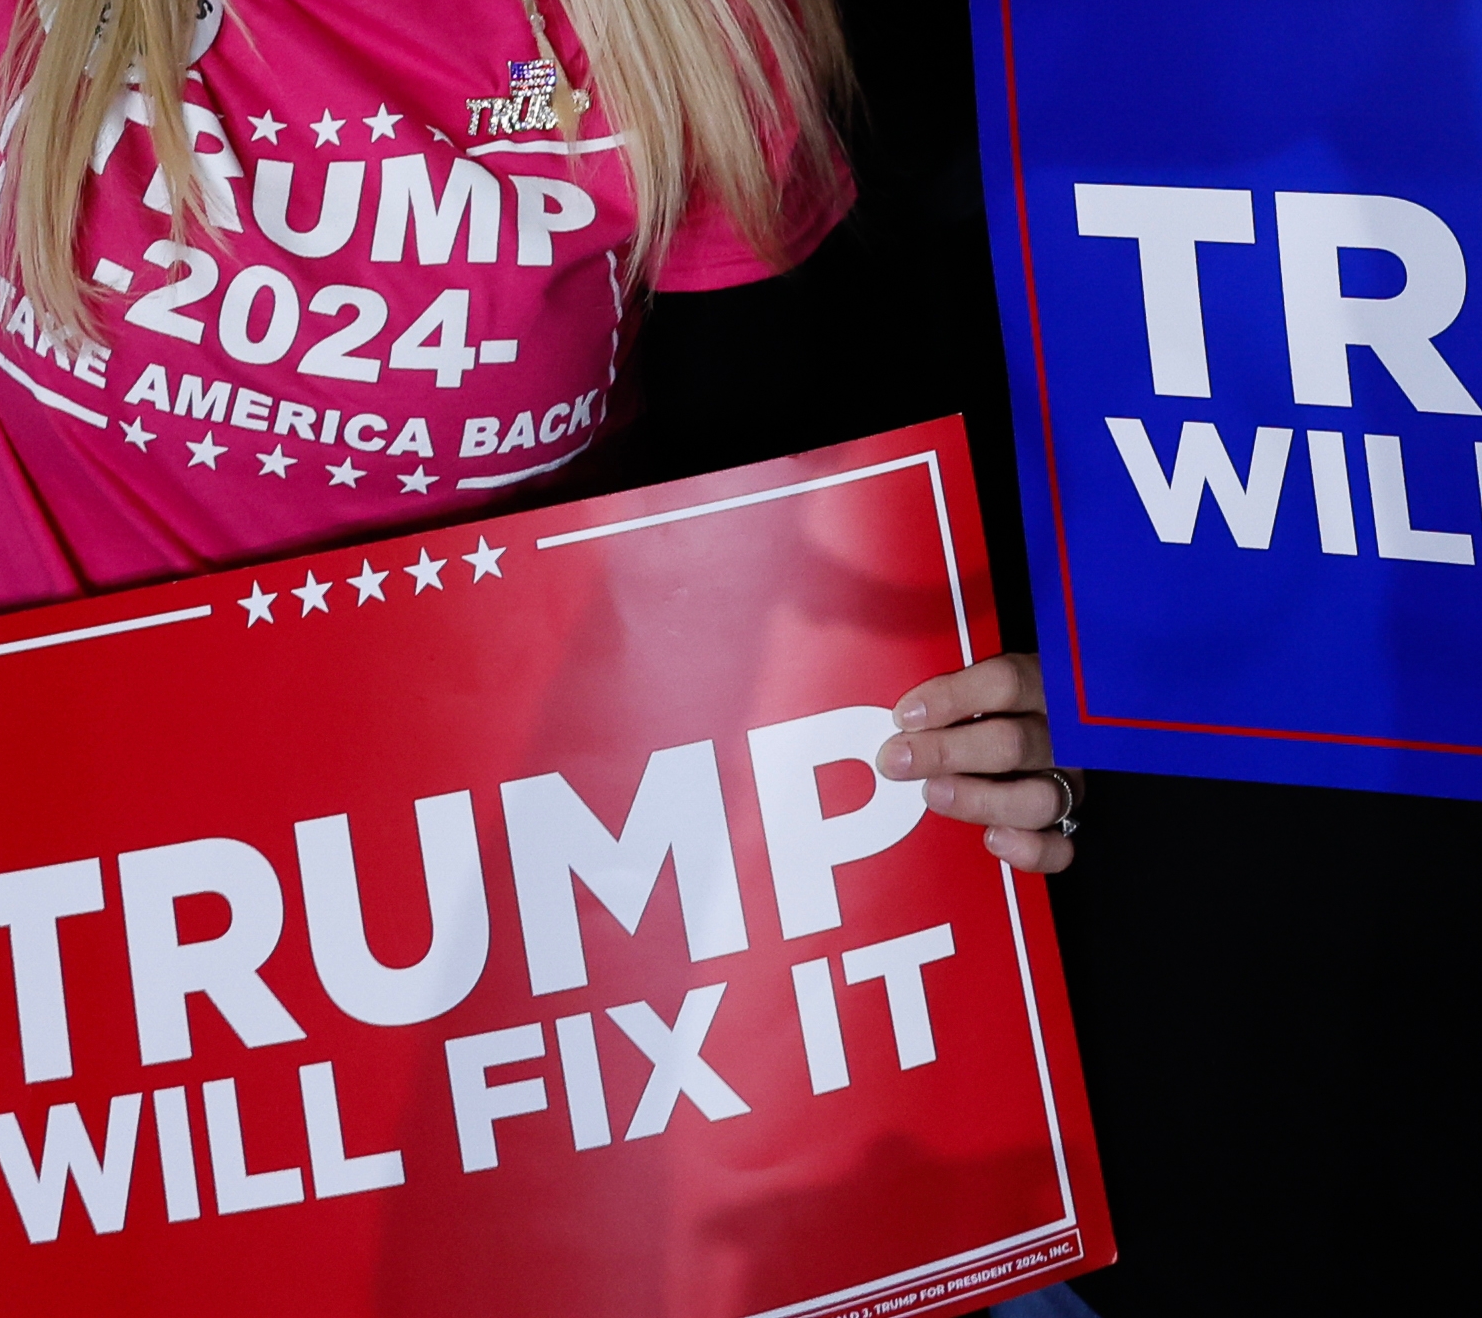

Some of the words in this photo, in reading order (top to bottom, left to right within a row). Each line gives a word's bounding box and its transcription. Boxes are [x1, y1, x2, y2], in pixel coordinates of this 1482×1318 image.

[123, 363, 435, 460] AMERICA
[458, 389, 601, 460] BACK
[447, 983, 752, 1175] FIX
[789, 923, 956, 1096] IT
[873, 1290, 918, 1317] TRUMP
[919, 1282, 945, 1302] FOR
[947, 1262, 1014, 1293] PRESIDENT
[1015, 1251, 1048, 1270] 2024,
[1048, 1242, 1074, 1259] INC.
